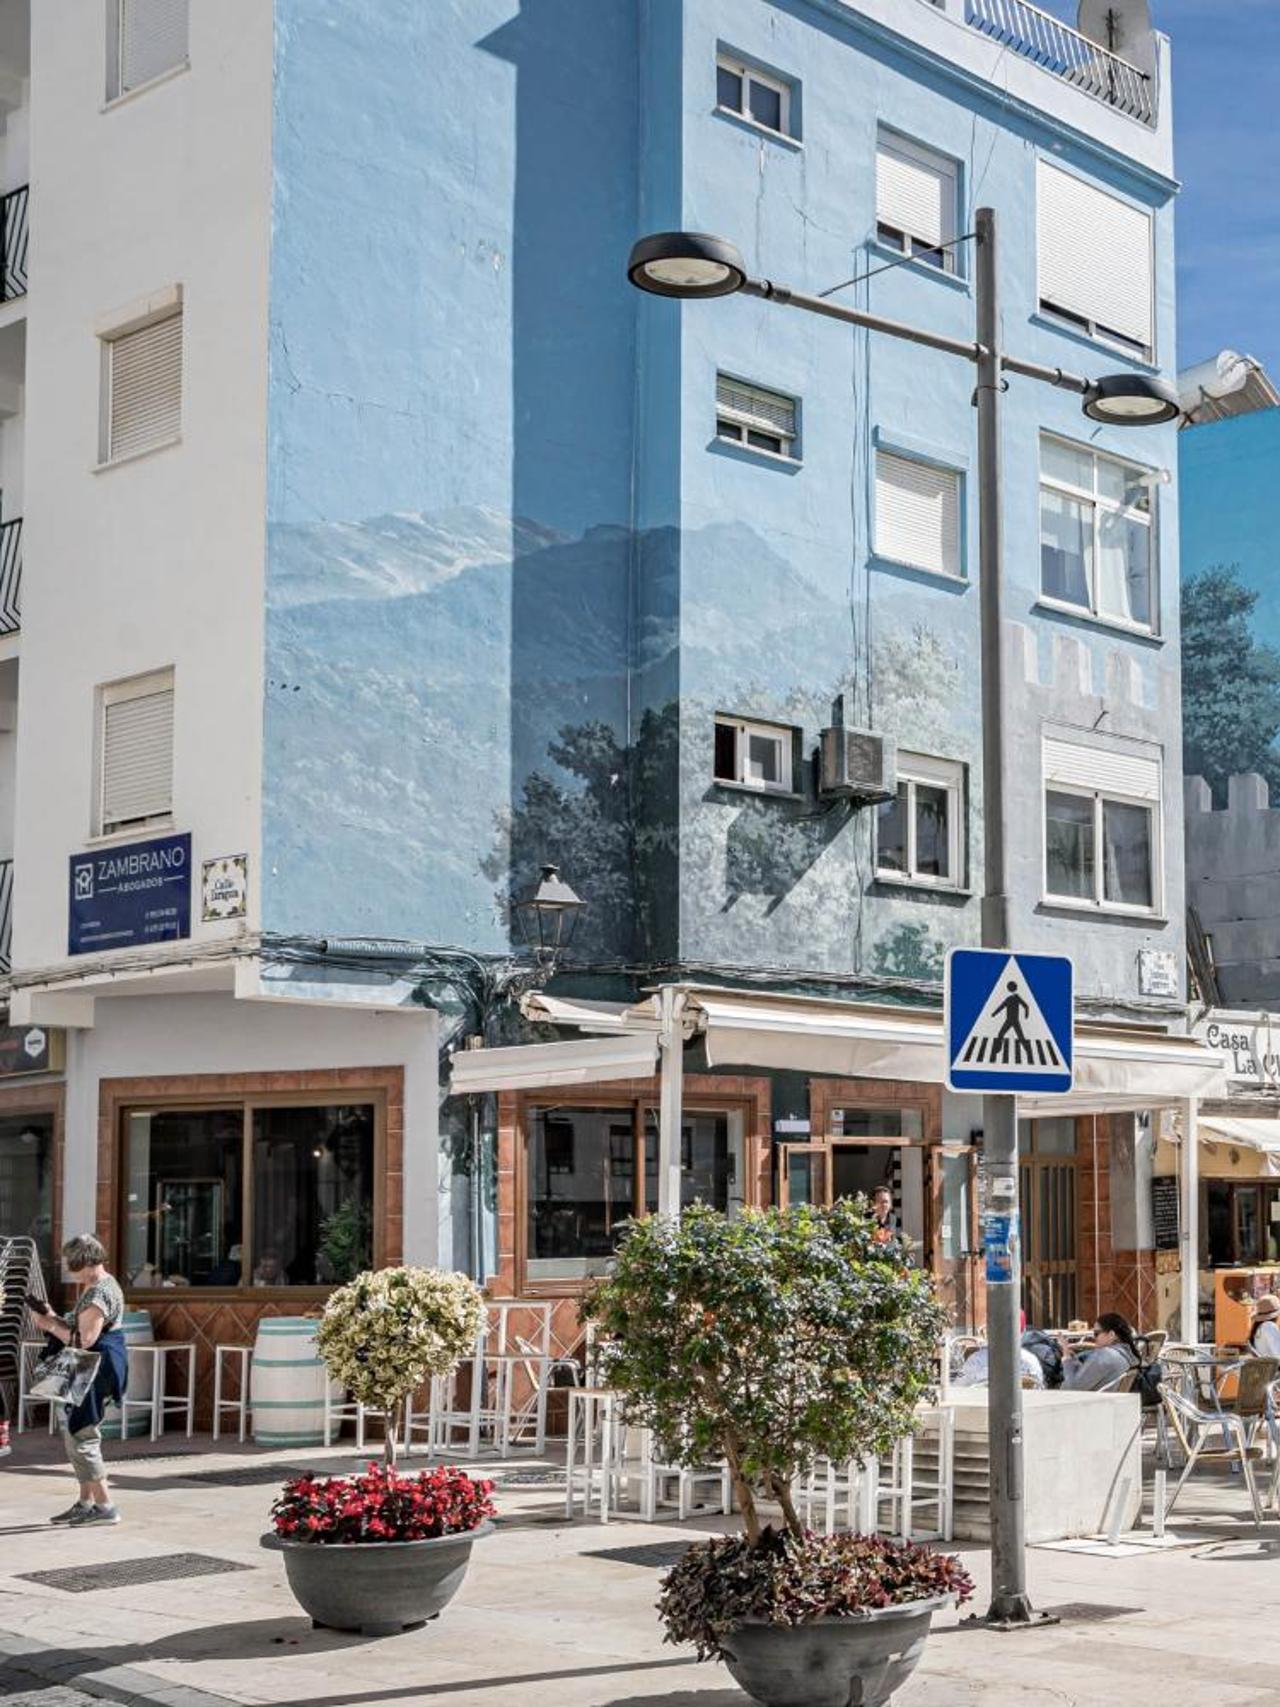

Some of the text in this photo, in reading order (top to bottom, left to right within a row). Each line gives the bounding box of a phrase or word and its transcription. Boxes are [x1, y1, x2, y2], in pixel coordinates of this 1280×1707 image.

[98, 847, 184, 880] ZAMBRANO
[117, 876, 164, 893] ABOGADOS
[1206, 1023, 1249, 1051] Casa
[1233, 1051, 1258, 1075] La
